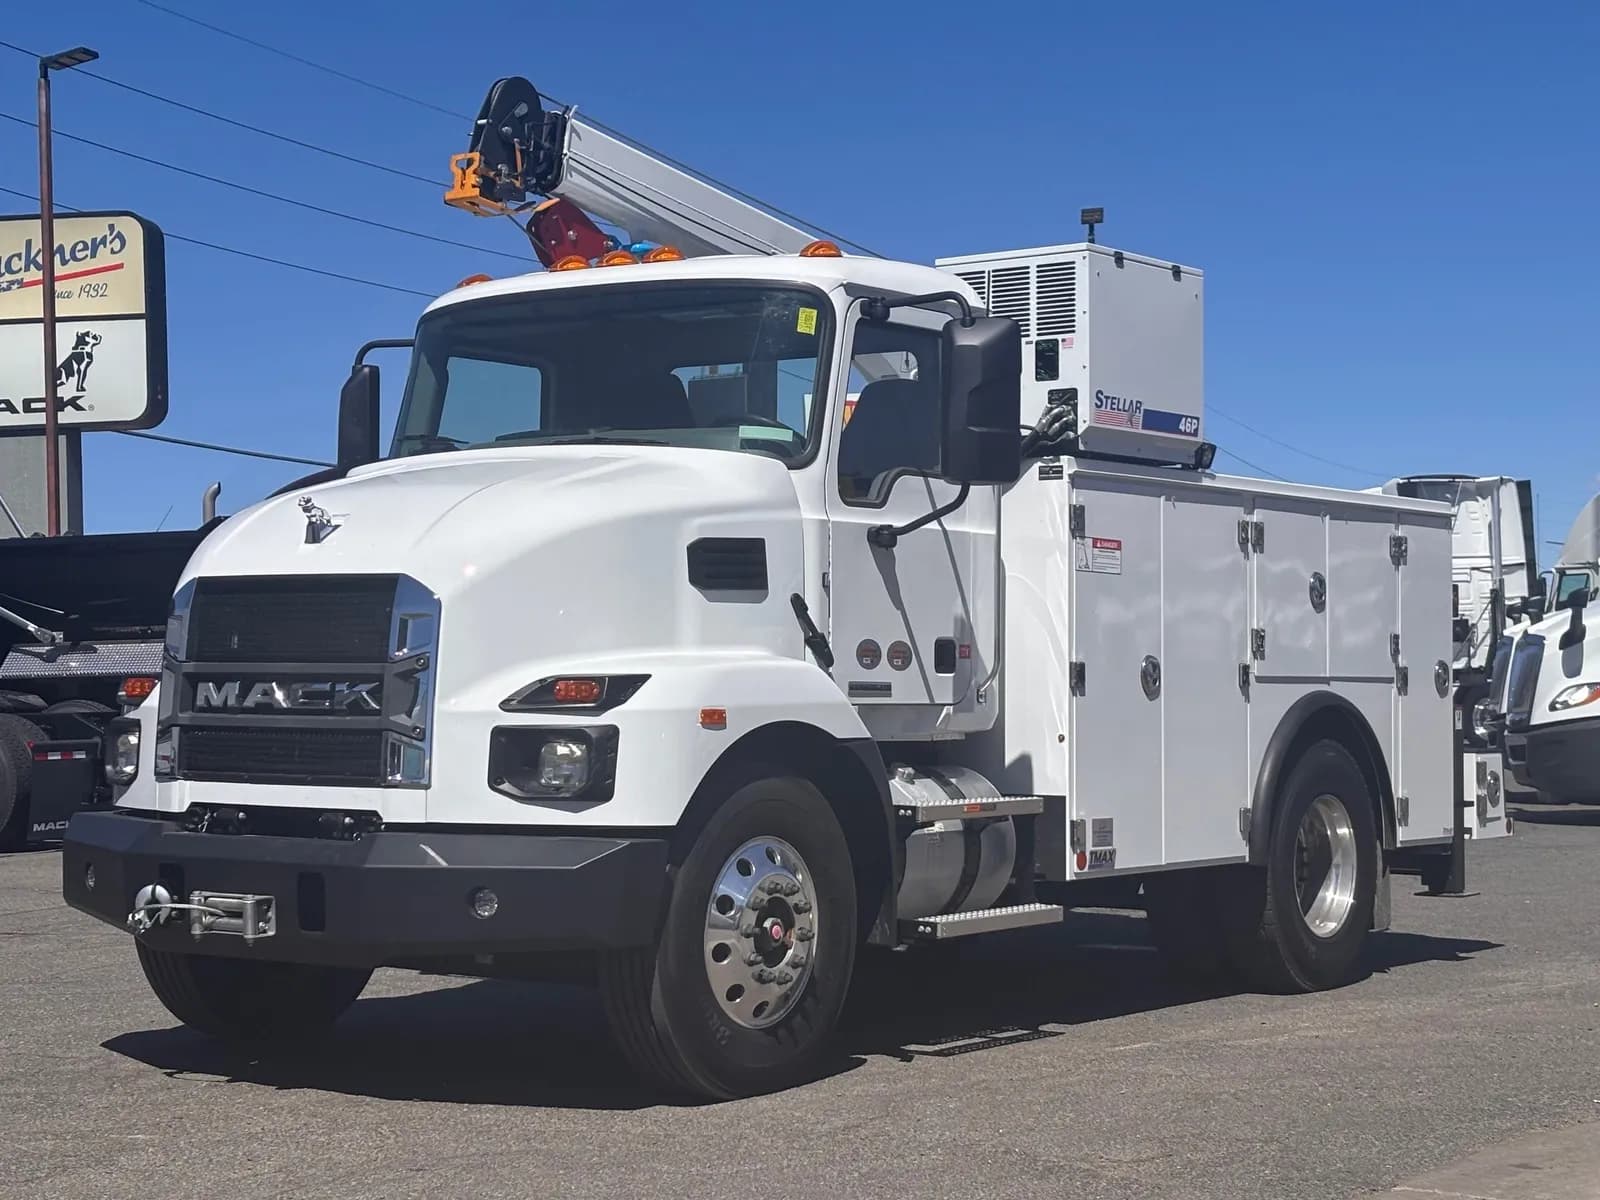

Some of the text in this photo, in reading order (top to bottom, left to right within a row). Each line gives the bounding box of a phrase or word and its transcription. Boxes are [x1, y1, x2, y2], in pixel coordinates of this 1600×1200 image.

[0, 224, 127, 277] ckner's
[78, 283, 108, 299] 1932
[1095, 390, 1142, 414] STELLAR
[1179, 416, 1198, 433] 46P
[196, 681, 380, 709] MACK
